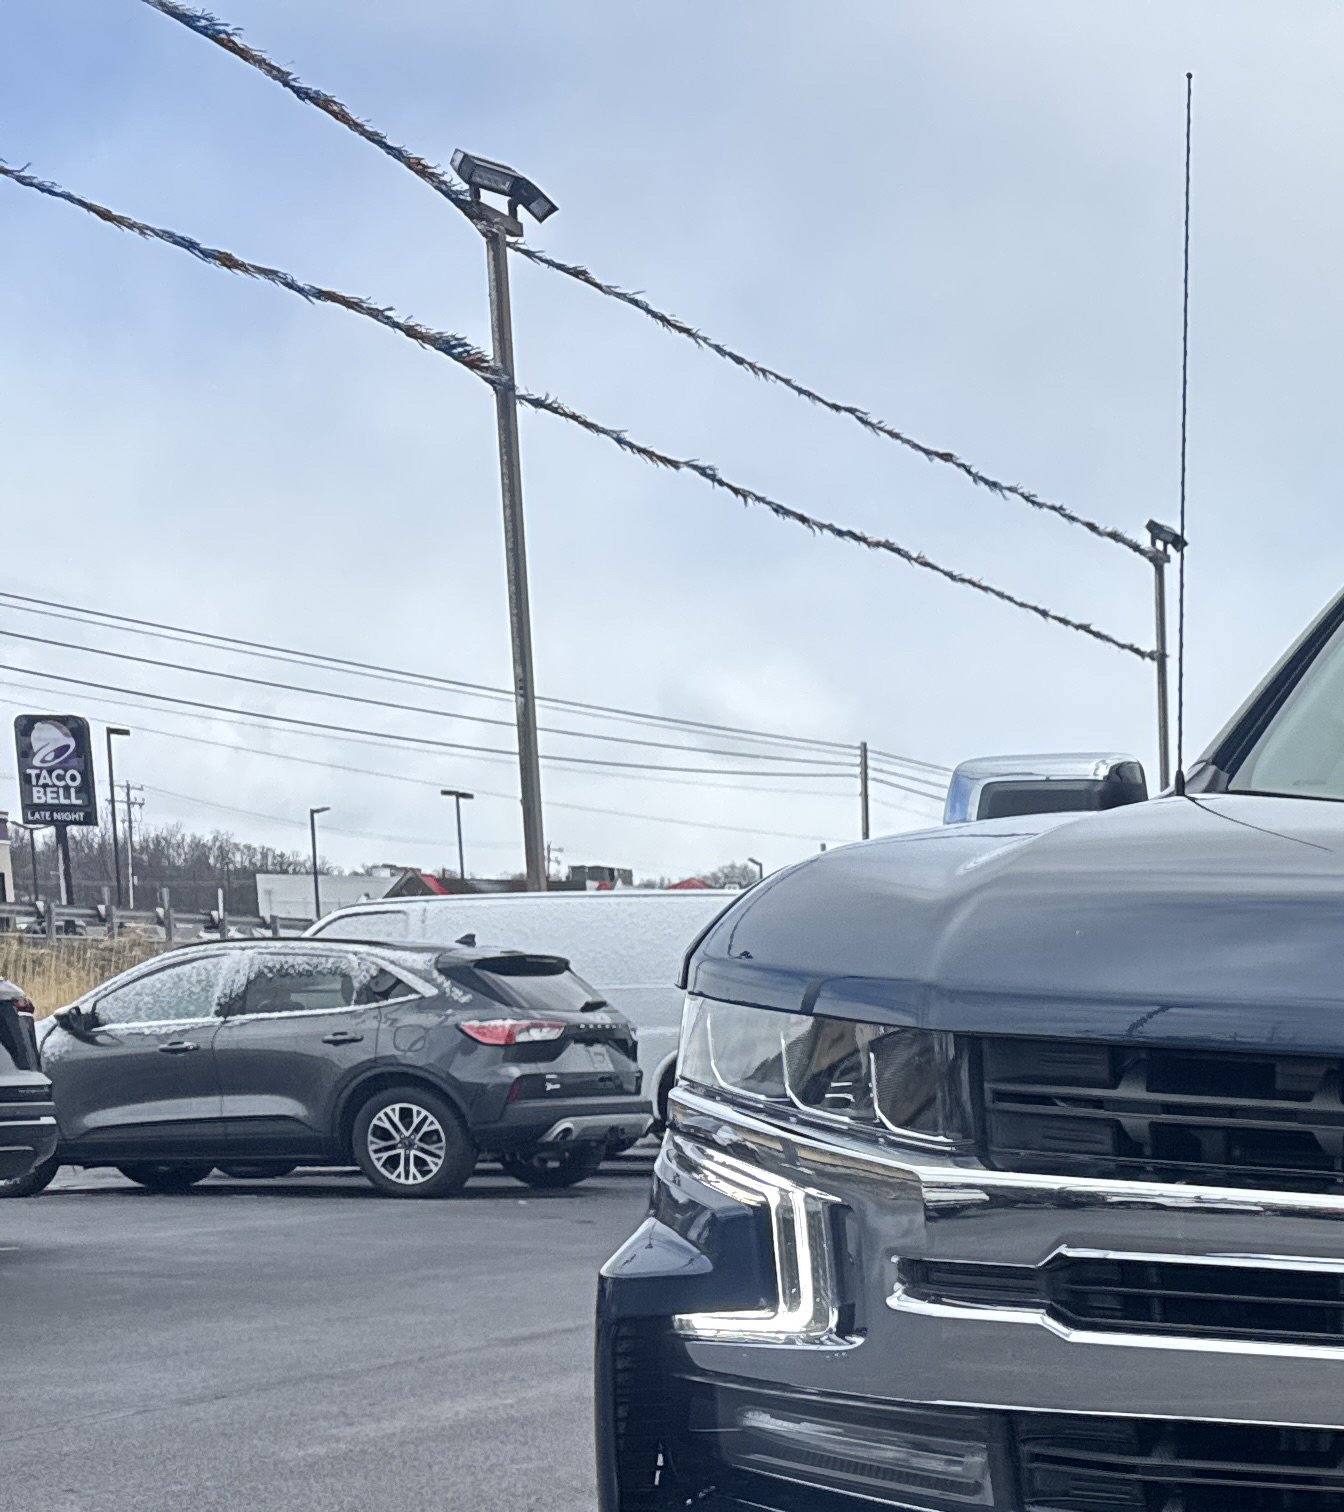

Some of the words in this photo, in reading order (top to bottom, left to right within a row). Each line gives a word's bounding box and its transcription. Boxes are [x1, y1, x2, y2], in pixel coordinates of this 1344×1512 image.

[26, 768, 82, 787] TACO
[32, 786, 83, 805] BELL
[27, 811, 51, 821] LATE
[53, 811, 85, 822] NIGHT
